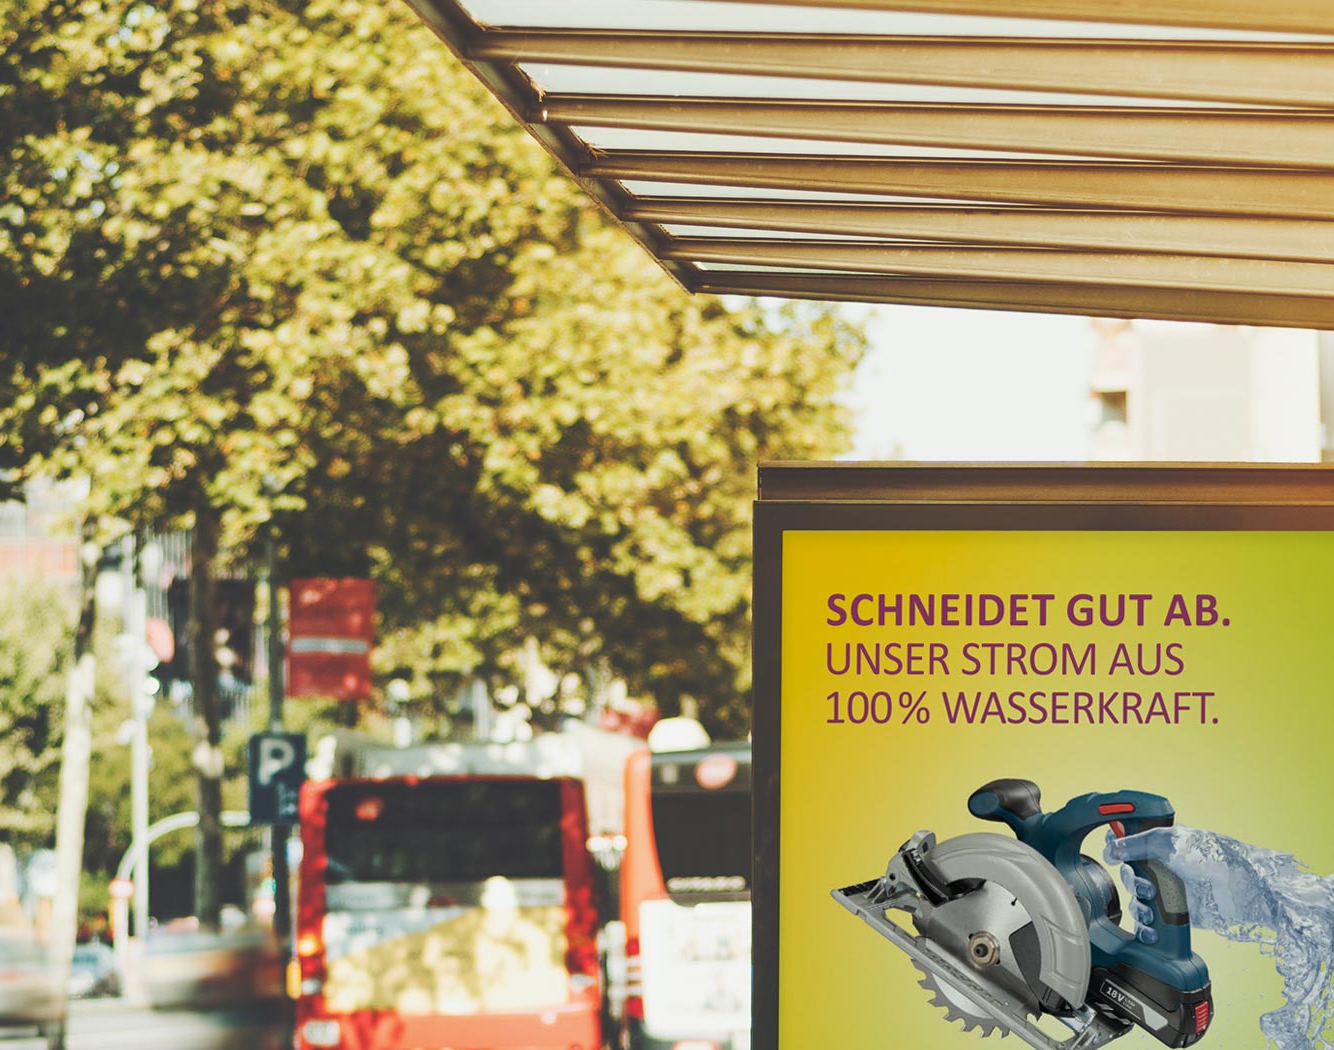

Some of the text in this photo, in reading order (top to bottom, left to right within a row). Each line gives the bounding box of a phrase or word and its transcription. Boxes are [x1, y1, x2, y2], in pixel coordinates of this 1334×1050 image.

[826, 593, 1231, 627] SCHNEIDET GUT AB.
[826, 642, 1185, 676] UNSER STROM AUS
[941, 690, 1219, 725] WASSERKRAFT.
